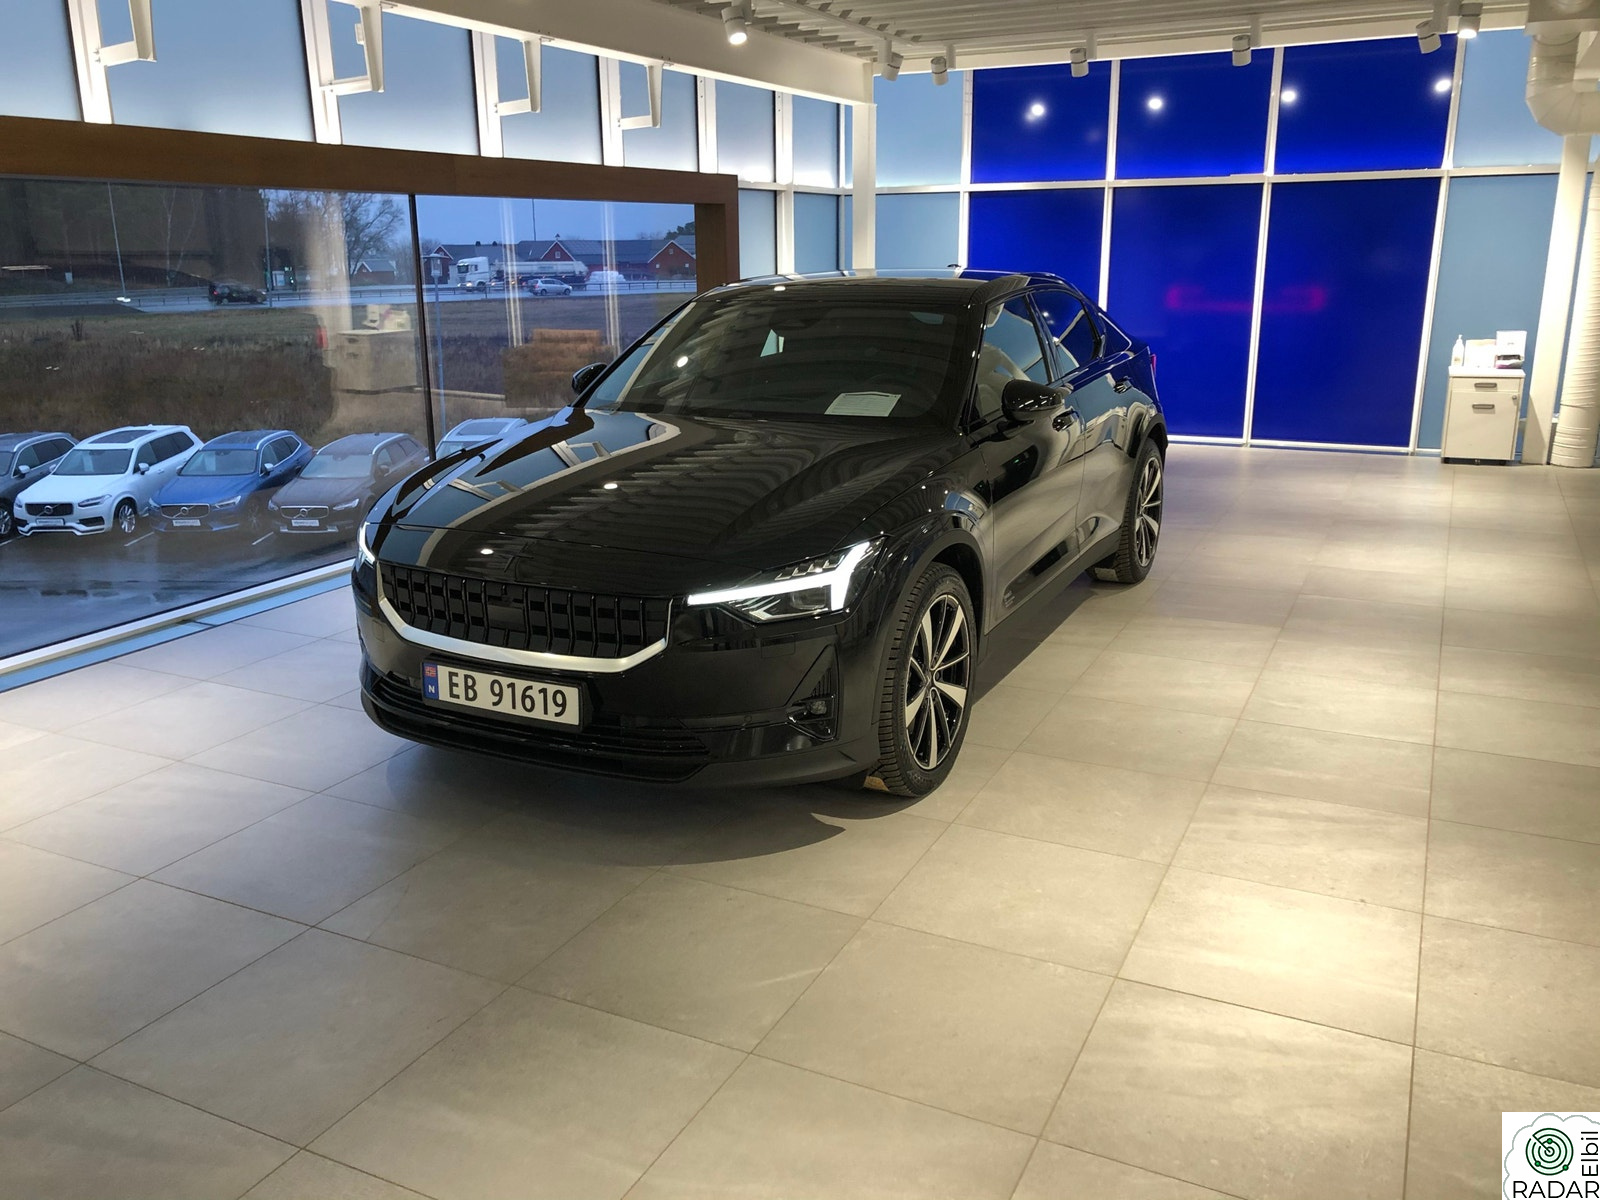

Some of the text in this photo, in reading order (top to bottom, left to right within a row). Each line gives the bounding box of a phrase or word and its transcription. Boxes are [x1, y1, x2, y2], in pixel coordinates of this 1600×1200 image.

[428, 684, 435, 694] N
[448, 671, 567, 717] EB 91619
